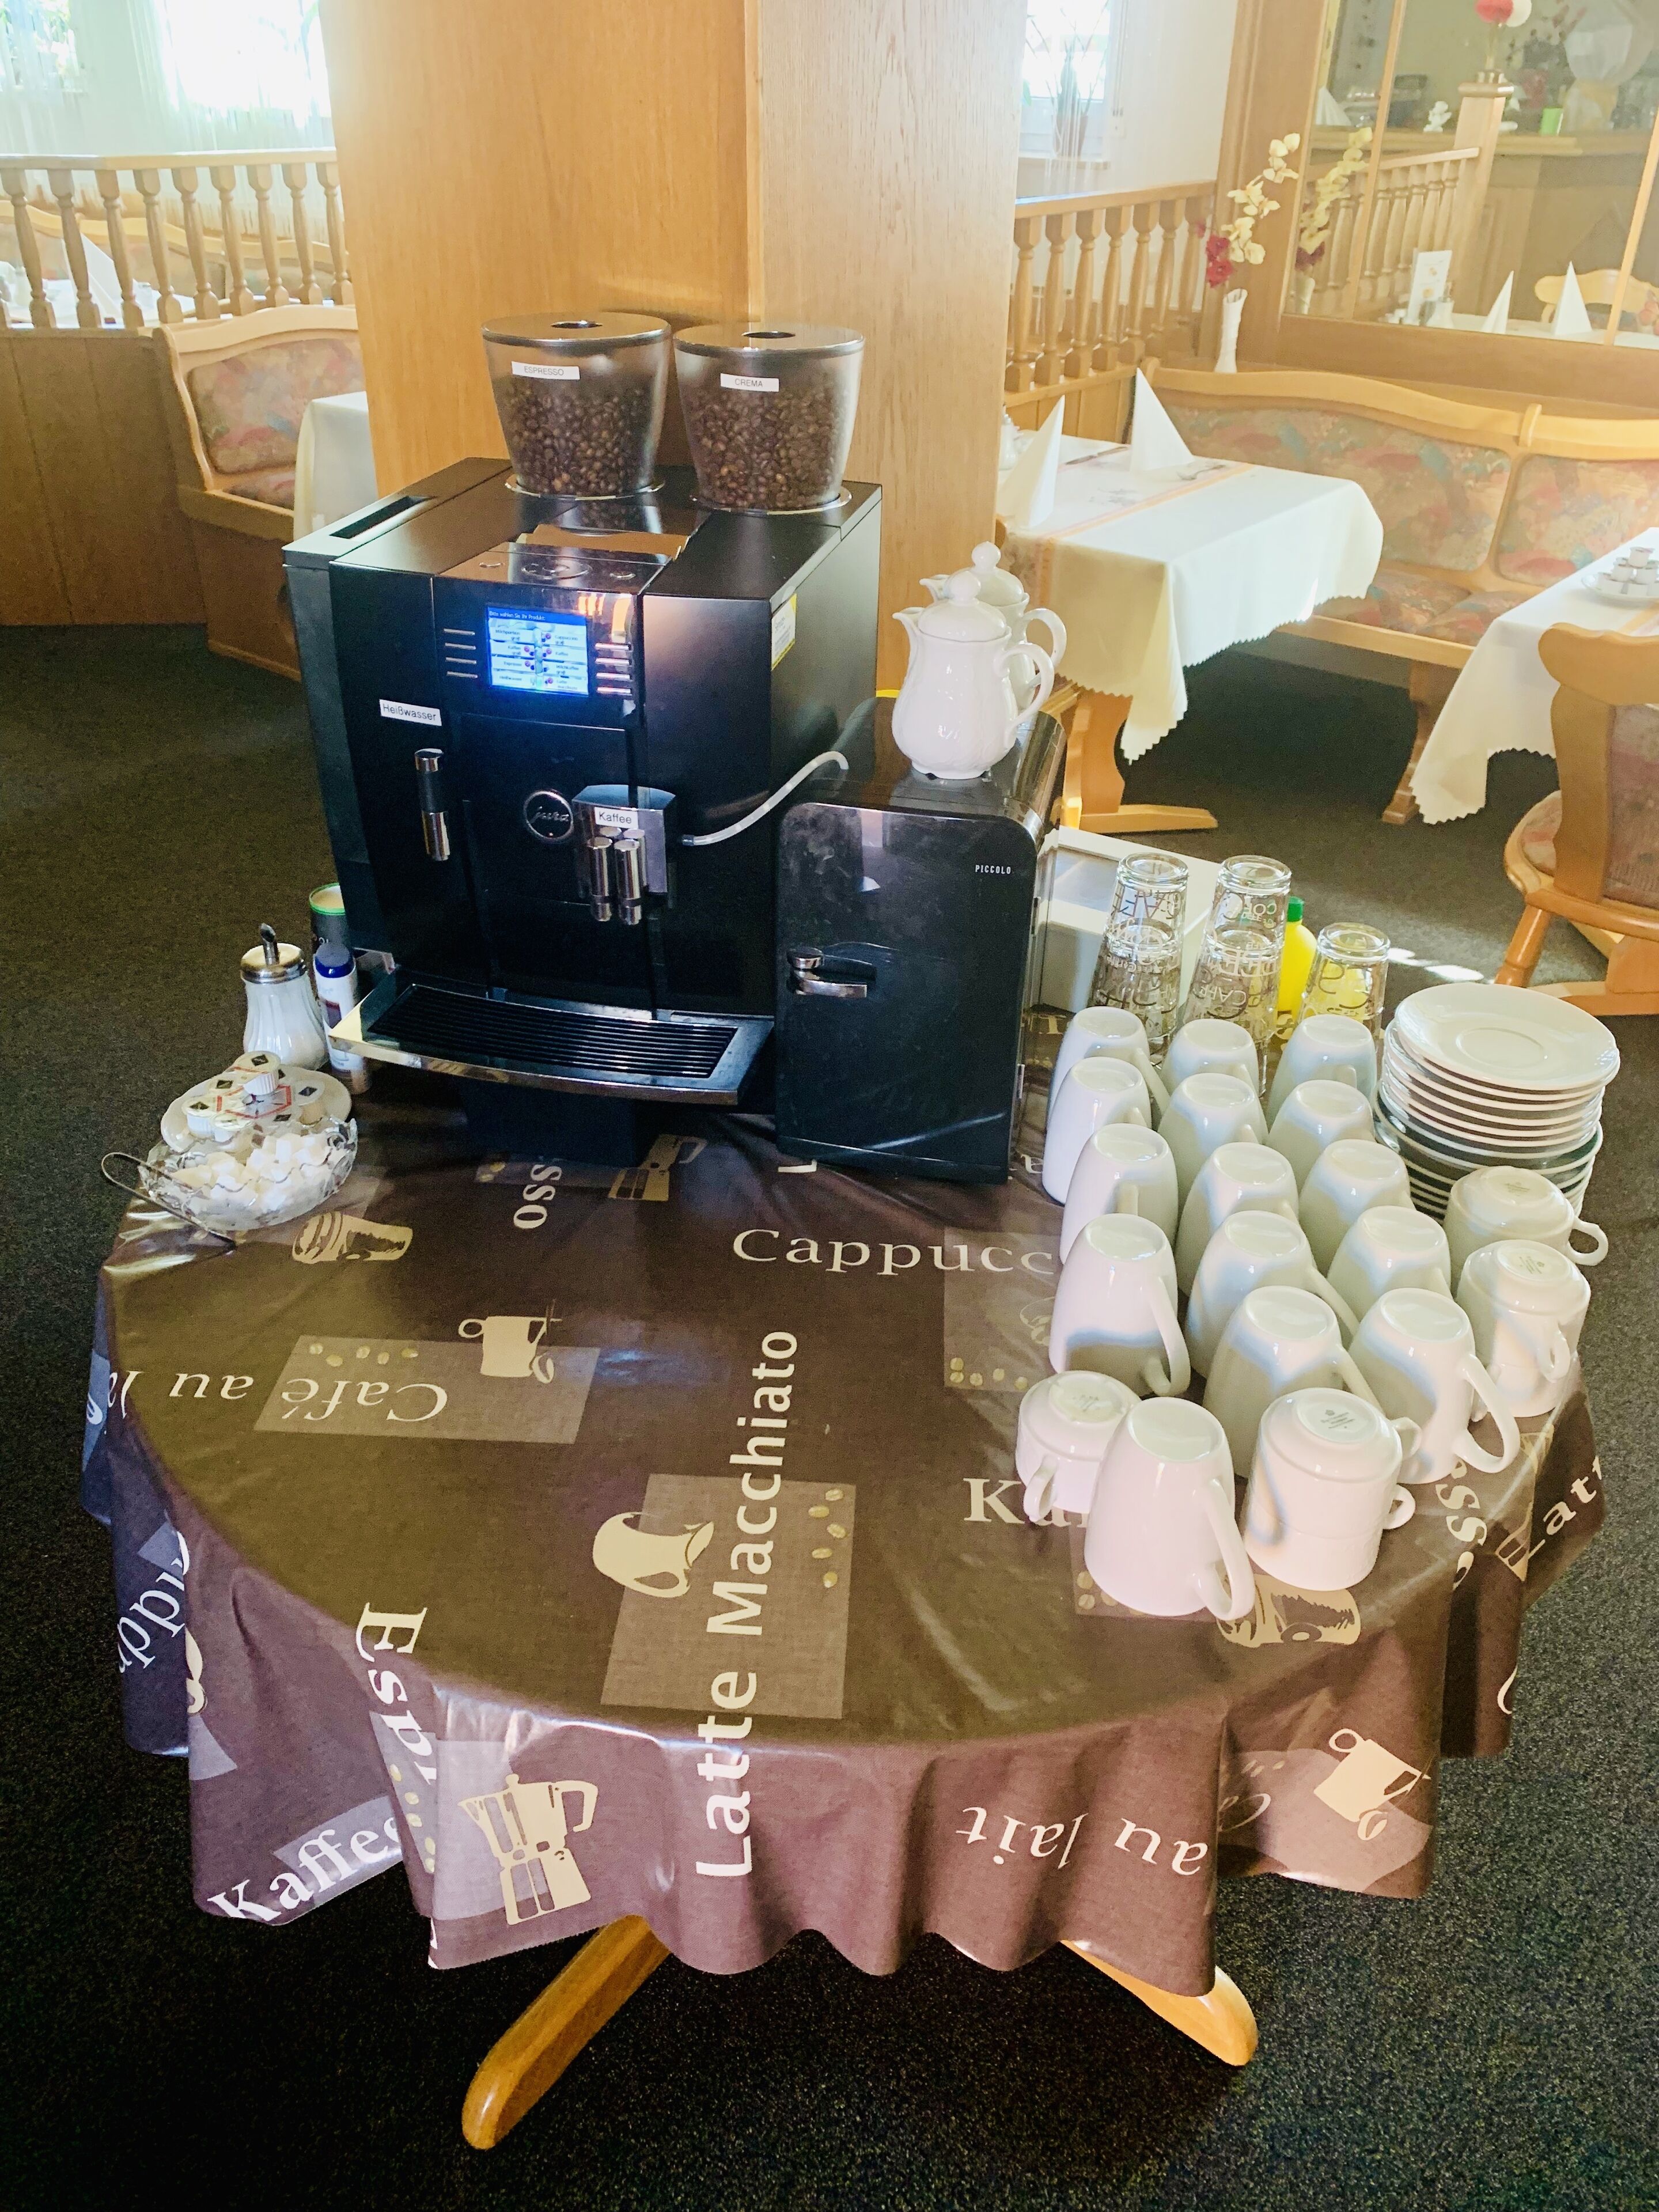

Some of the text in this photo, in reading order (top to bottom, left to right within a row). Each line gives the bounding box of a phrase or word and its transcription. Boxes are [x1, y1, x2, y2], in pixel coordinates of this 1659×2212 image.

[524, 365, 565, 377] ESPRESSO
[734, 377, 763, 388] CREMA
[382, 703, 437, 722] Heißwasser
[598, 811, 632, 824] Kaffee
[975, 864, 1012, 874] PICCOLO
[169, 1373, 254, 1400] au
[281, 1377, 448, 1422] Café
[696, 1330, 798, 1878] Latte Macchiato
[955, 1806, 1209, 1876] au lait
